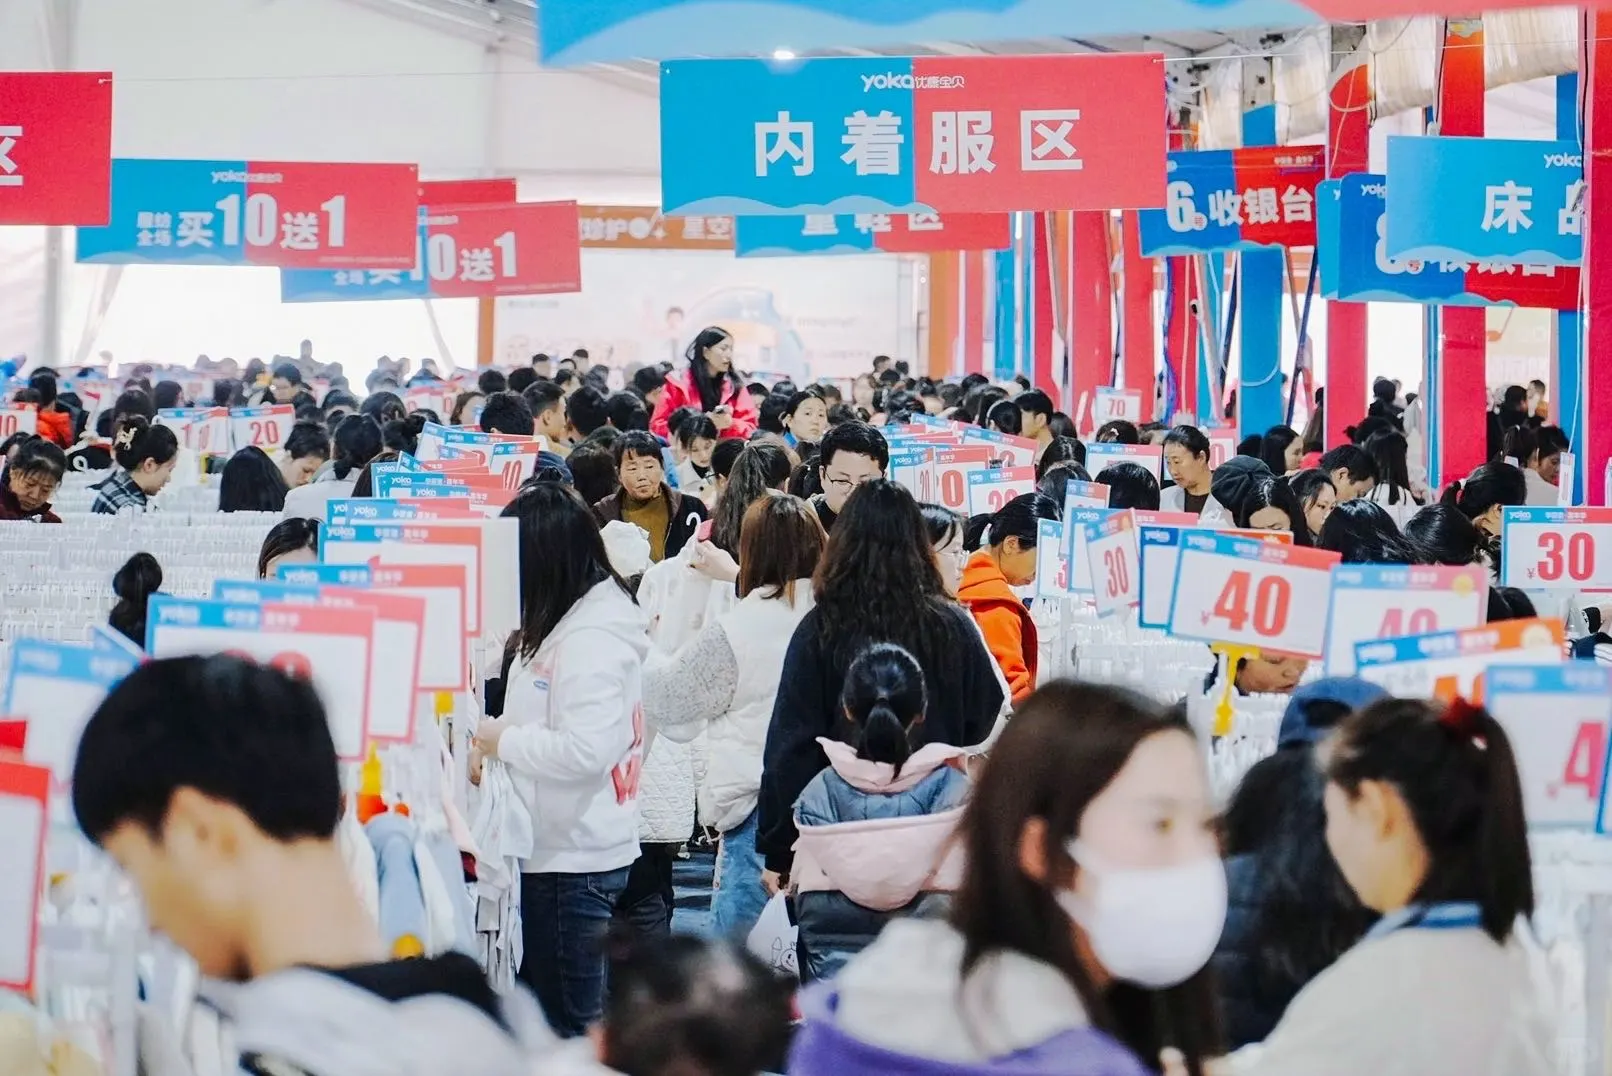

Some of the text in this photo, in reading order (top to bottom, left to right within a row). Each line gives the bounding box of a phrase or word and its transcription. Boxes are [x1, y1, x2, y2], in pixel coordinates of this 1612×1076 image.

[861, 71, 914, 93] yoka
[754, 109, 1084, 177] 内着服区
[176, 192, 346, 249] 买10送1
[1108, 398, 1126, 417] 70
[249, 420, 280, 446] 20
[1103, 546, 1130, 598] 30
